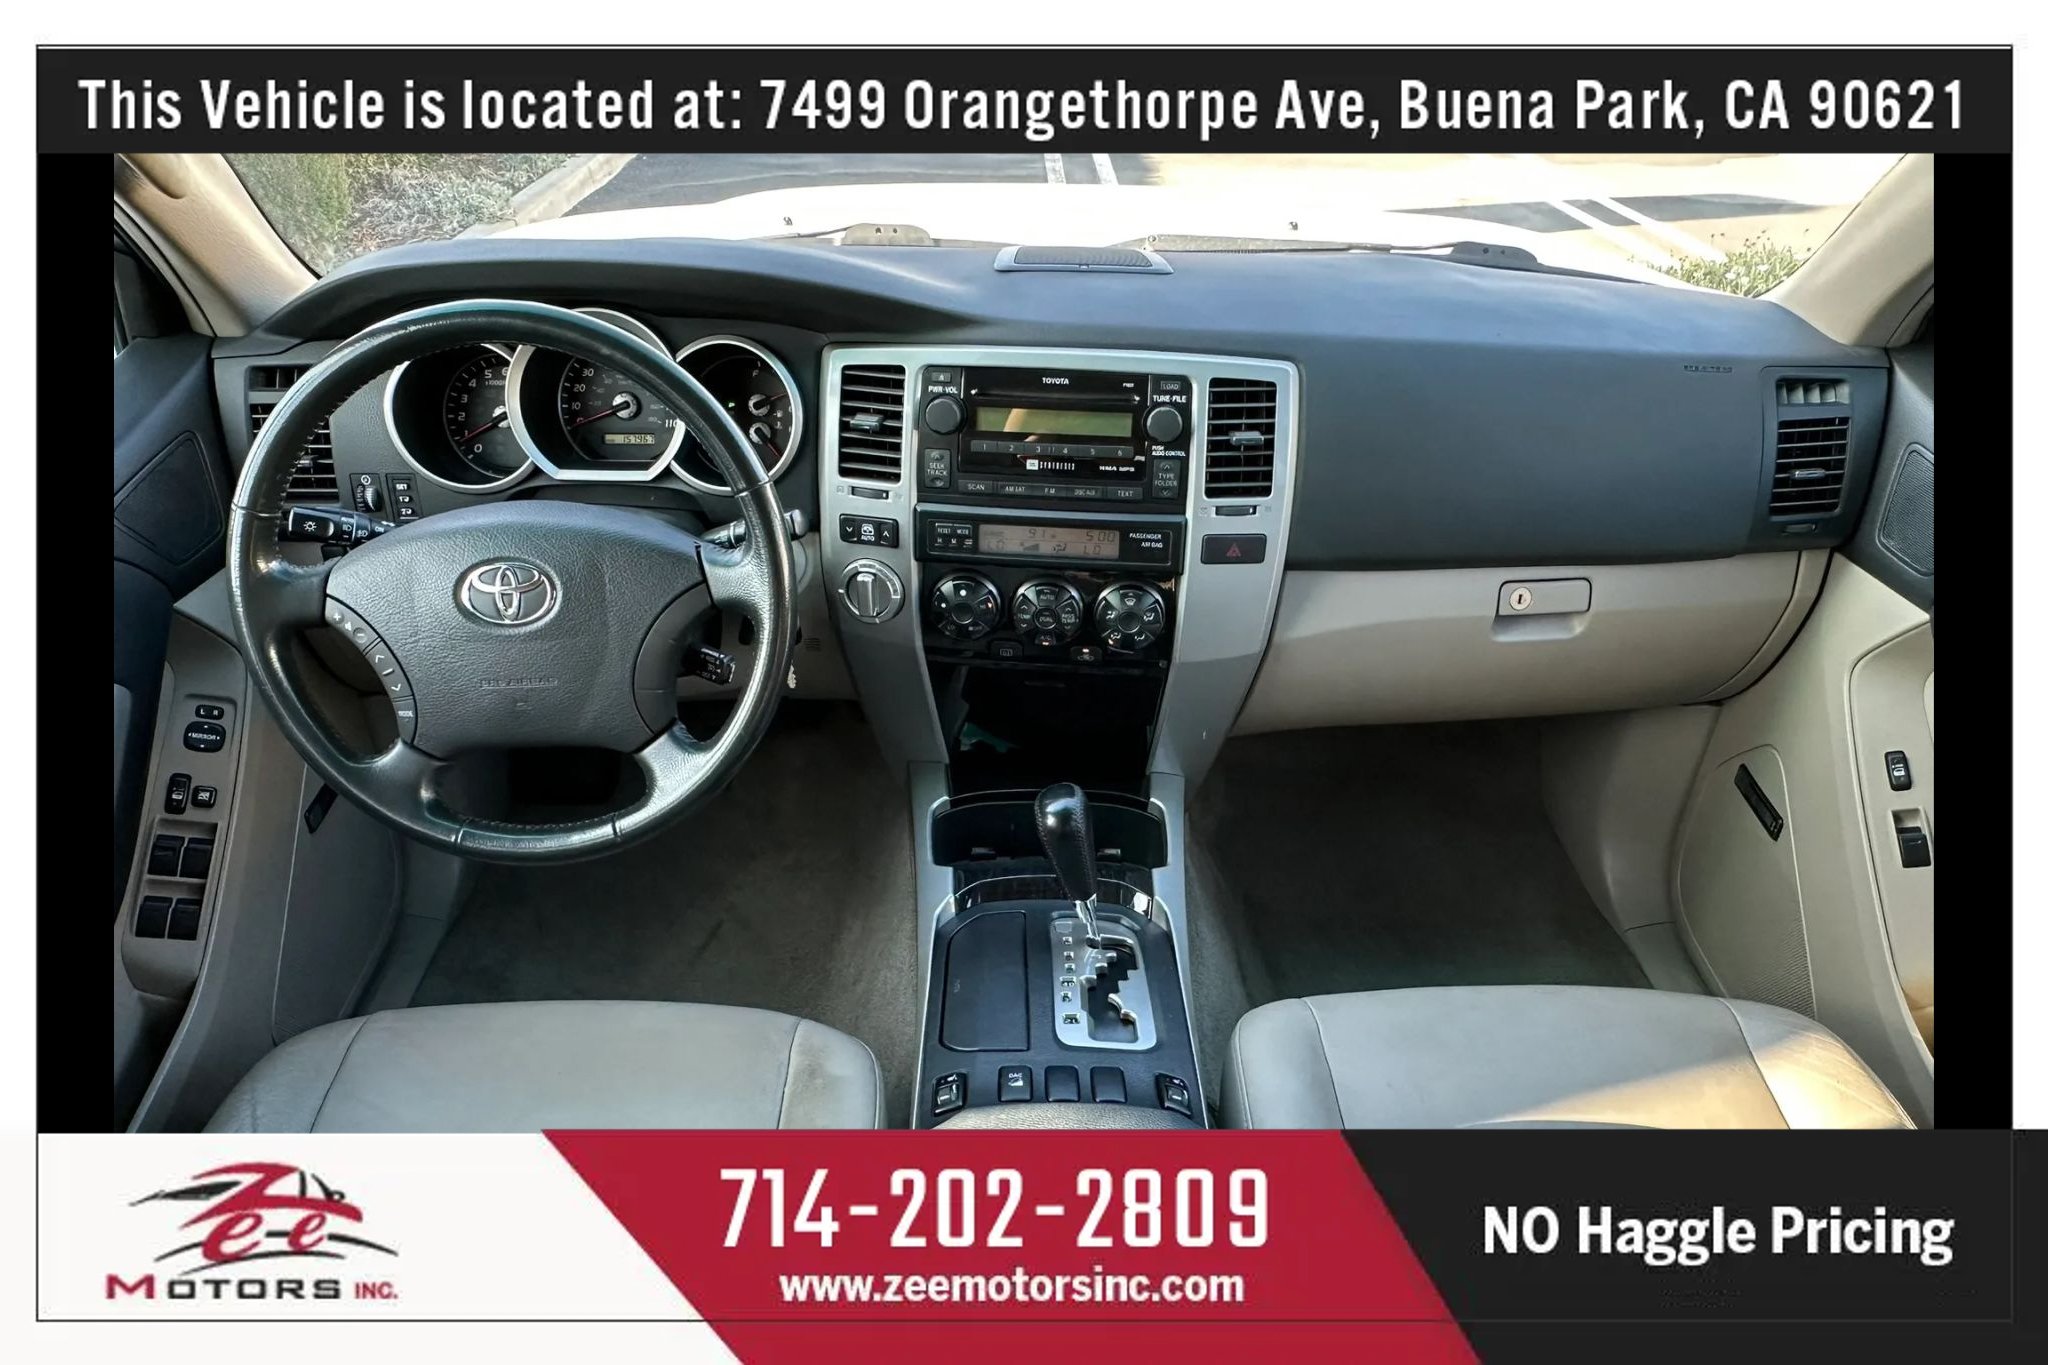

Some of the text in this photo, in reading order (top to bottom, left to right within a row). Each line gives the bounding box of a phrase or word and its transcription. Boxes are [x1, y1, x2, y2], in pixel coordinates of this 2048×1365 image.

[484, 369, 492, 379] 5
[582, 368, 594, 377] 30
[468, 379, 477, 387] 4
[1042, 377, 1069, 385] TOYOTA
[573, 384, 586, 392] 20
[460, 394, 468, 403] 3
[572, 402, 581, 410] 10
[458, 412, 466, 421] 2
[474, 444, 482, 453] 0
[927, 468, 947, 476] TRACK
[1129, 532, 1162, 540] PASSENGER
